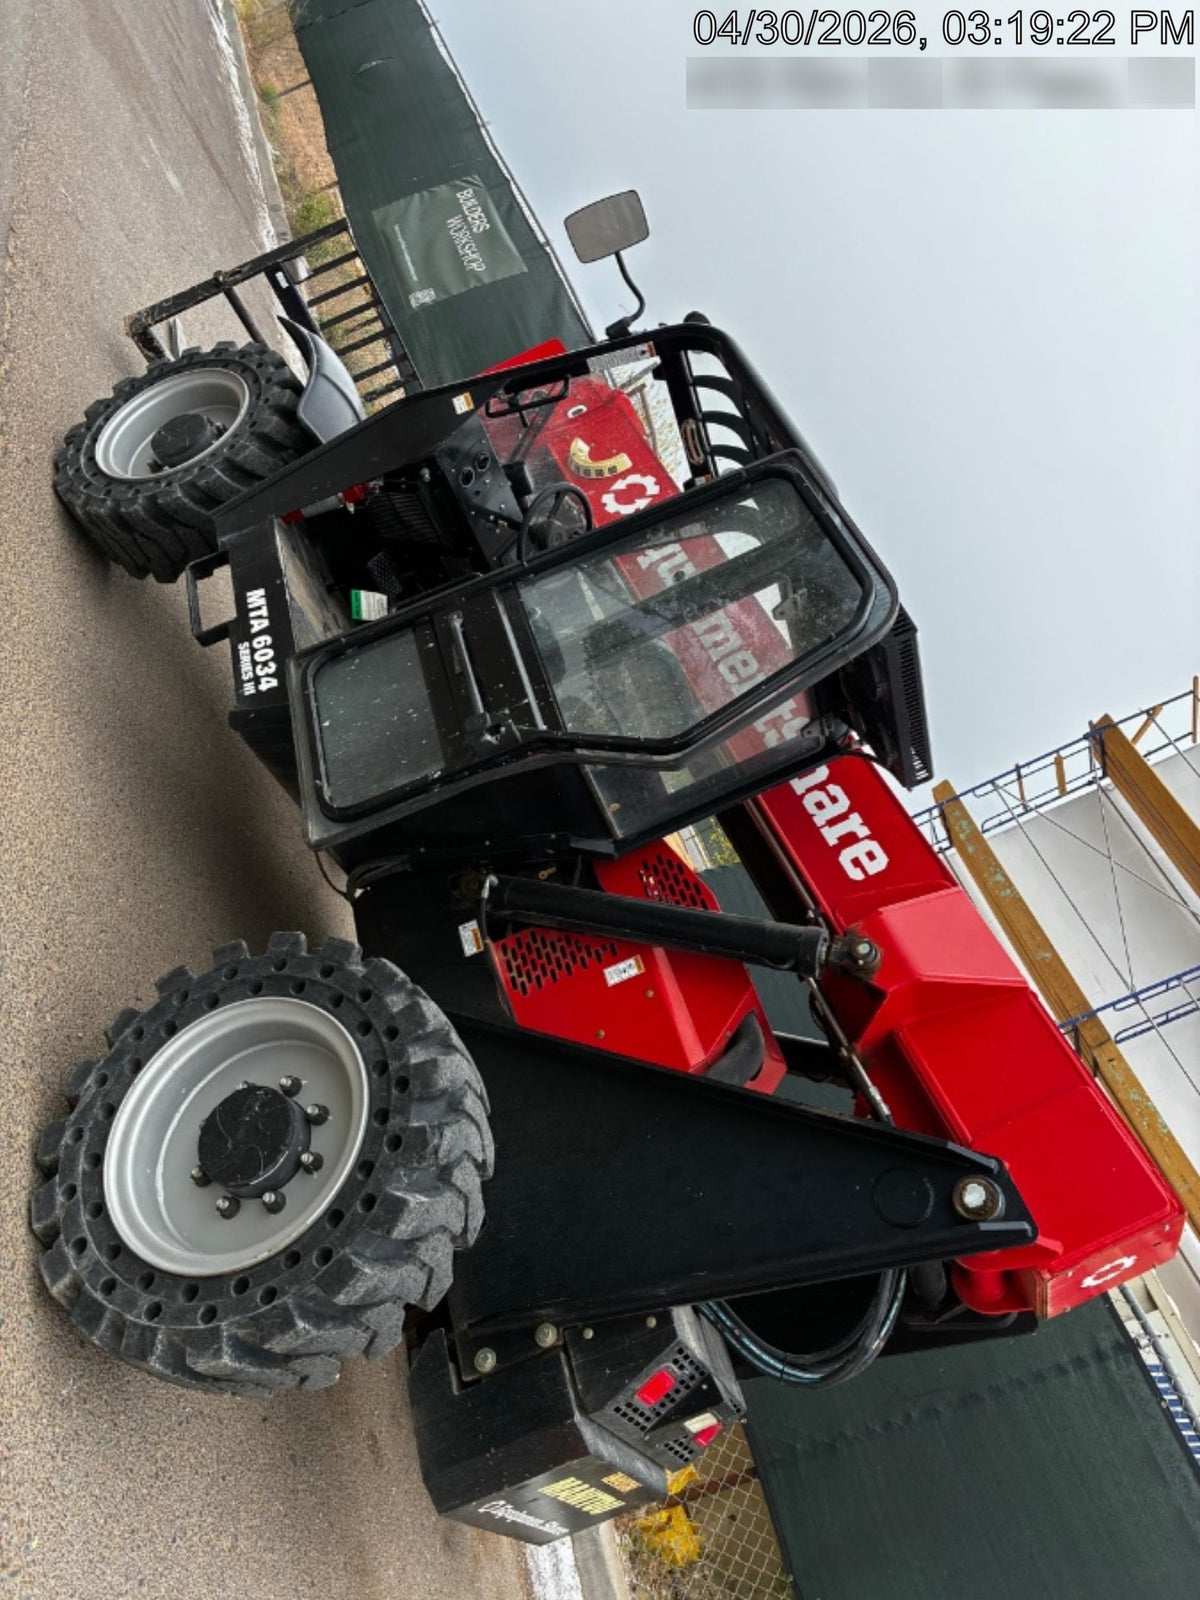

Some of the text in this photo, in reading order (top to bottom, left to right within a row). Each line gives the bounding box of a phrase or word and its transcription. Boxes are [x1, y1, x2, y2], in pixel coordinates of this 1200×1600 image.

[456, 188, 489, 233] BUILDERS
[446, 215, 486, 271] WORKSHOP
[238, 641, 254, 681] SERIES
[246, 588, 278, 692] MTA 6034
